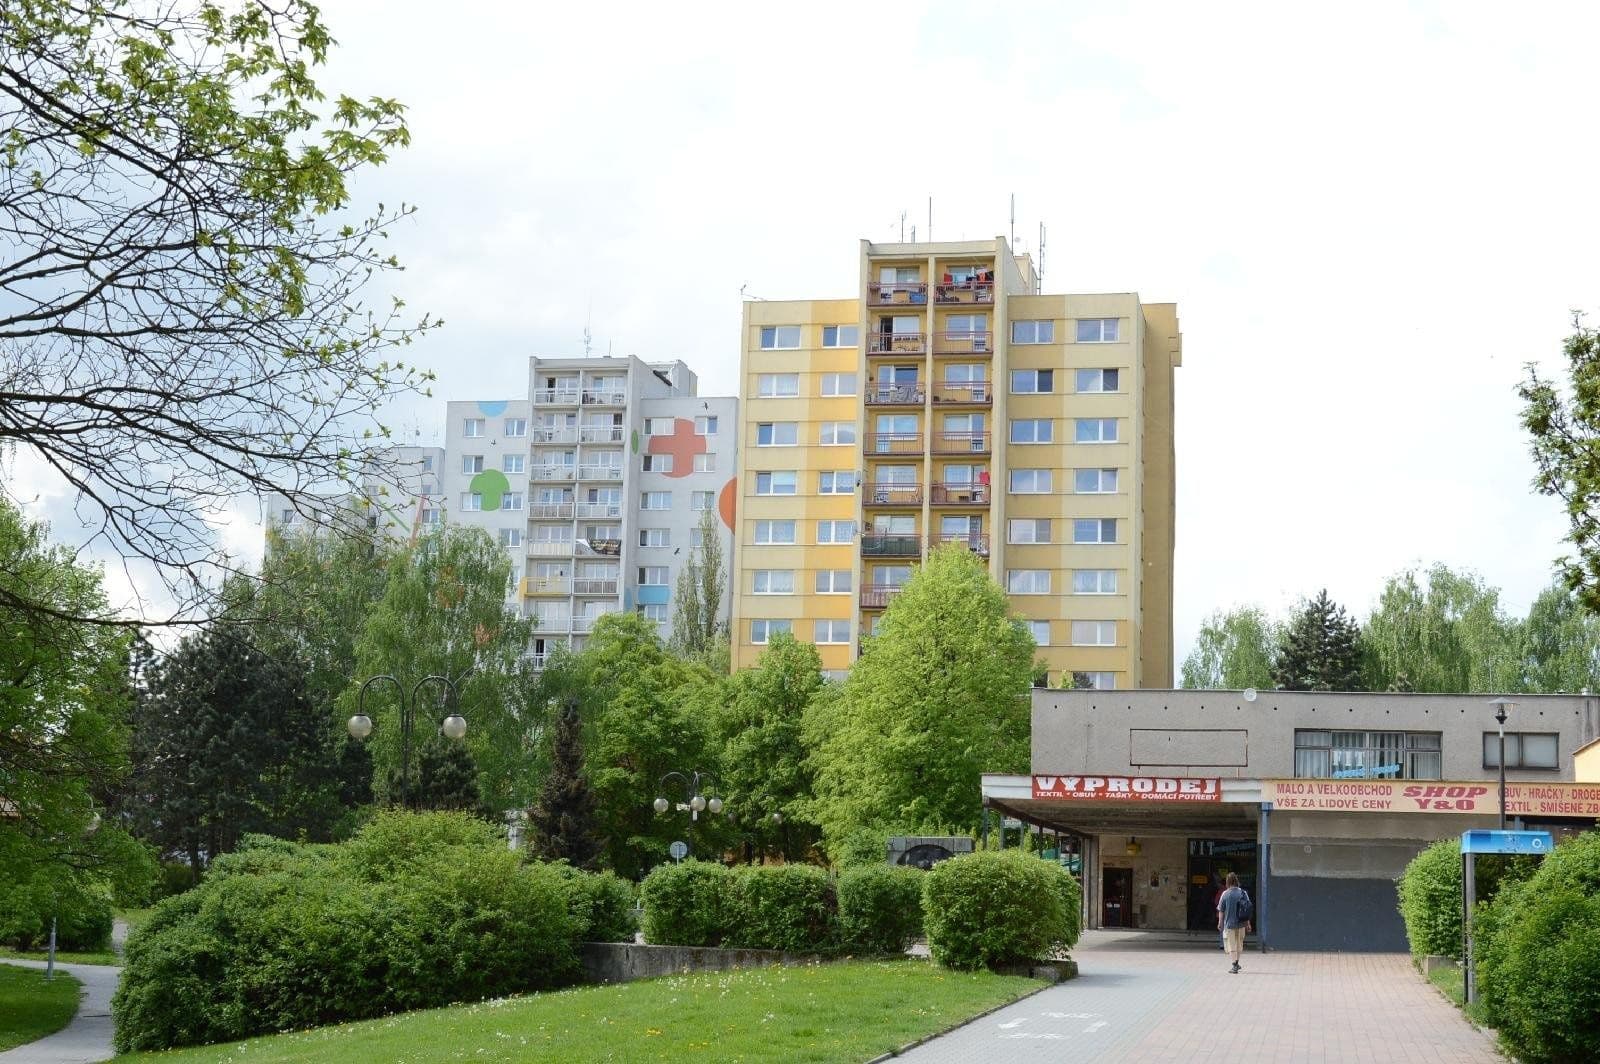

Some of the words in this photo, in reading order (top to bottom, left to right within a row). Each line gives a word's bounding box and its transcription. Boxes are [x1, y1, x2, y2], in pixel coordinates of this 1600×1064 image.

[1276, 783, 1304, 795] MALO
[1307, 784, 1315, 795] A
[1317, 784, 1393, 796] VELKOOBCHOD
[1403, 786, 1488, 798] SHOP
[1528, 785, 1565, 800] HRAČKY
[1276, 796, 1298, 808] VŠE
[1301, 798, 1316, 808] ZA
[1319, 797, 1359, 808] LIDOVÉ
[1362, 799, 1392, 809] CENY
[1414, 799, 1475, 811] Y&O
[1585, 803, 1600, 814] ZB
